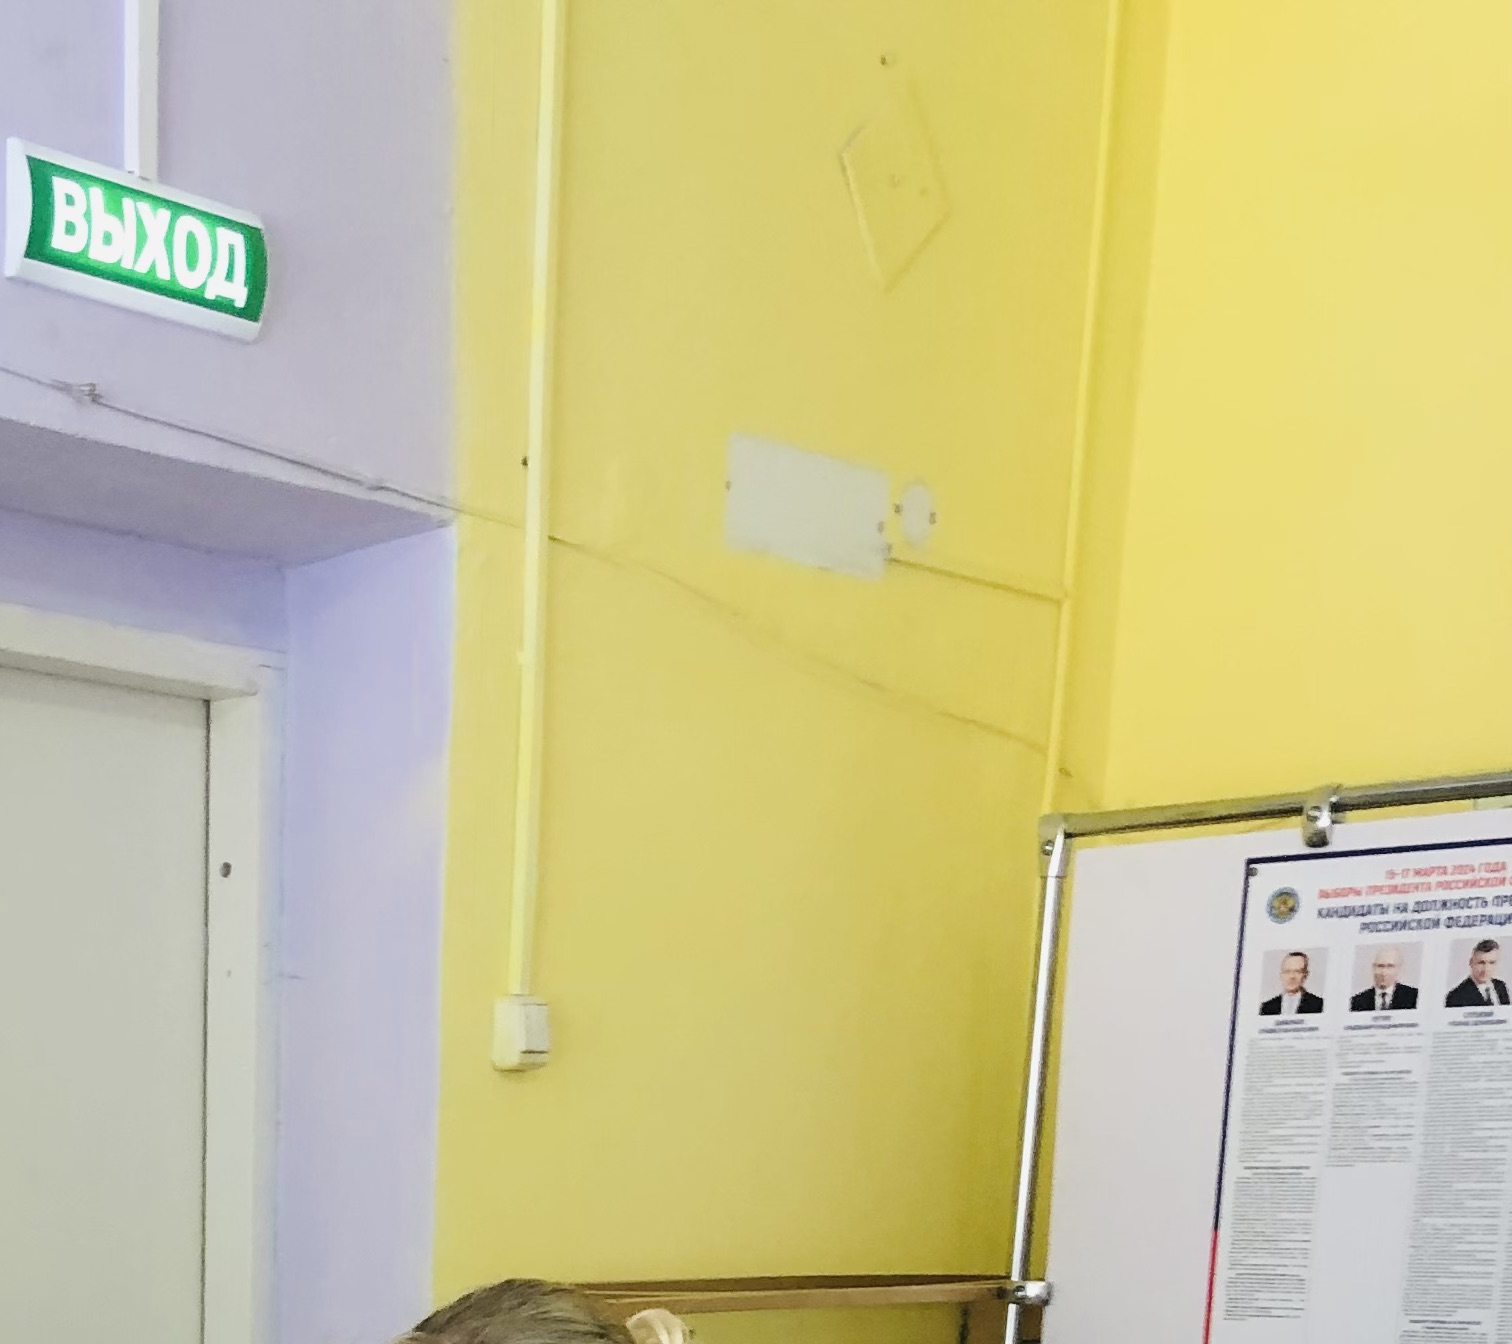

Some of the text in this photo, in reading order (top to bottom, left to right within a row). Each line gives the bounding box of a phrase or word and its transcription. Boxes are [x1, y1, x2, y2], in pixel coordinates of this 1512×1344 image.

[50, 175, 249, 309] ВЫХОД
[1478, 861, 1507, 874] ГОДА
[1364, 882, 1432, 898] ПРЕЗИДЕНТА
[1434, 876, 1507, 892] РОССИЙСКОЙ
[1317, 903, 1390, 919] КАНДИДАТЫ
[1392, 901, 1409, 914] НА
[1411, 896, 1488, 914] ДОЛЖНОСТЬ
[1359, 917, 1441, 934] РОССИЙСКОЙ
